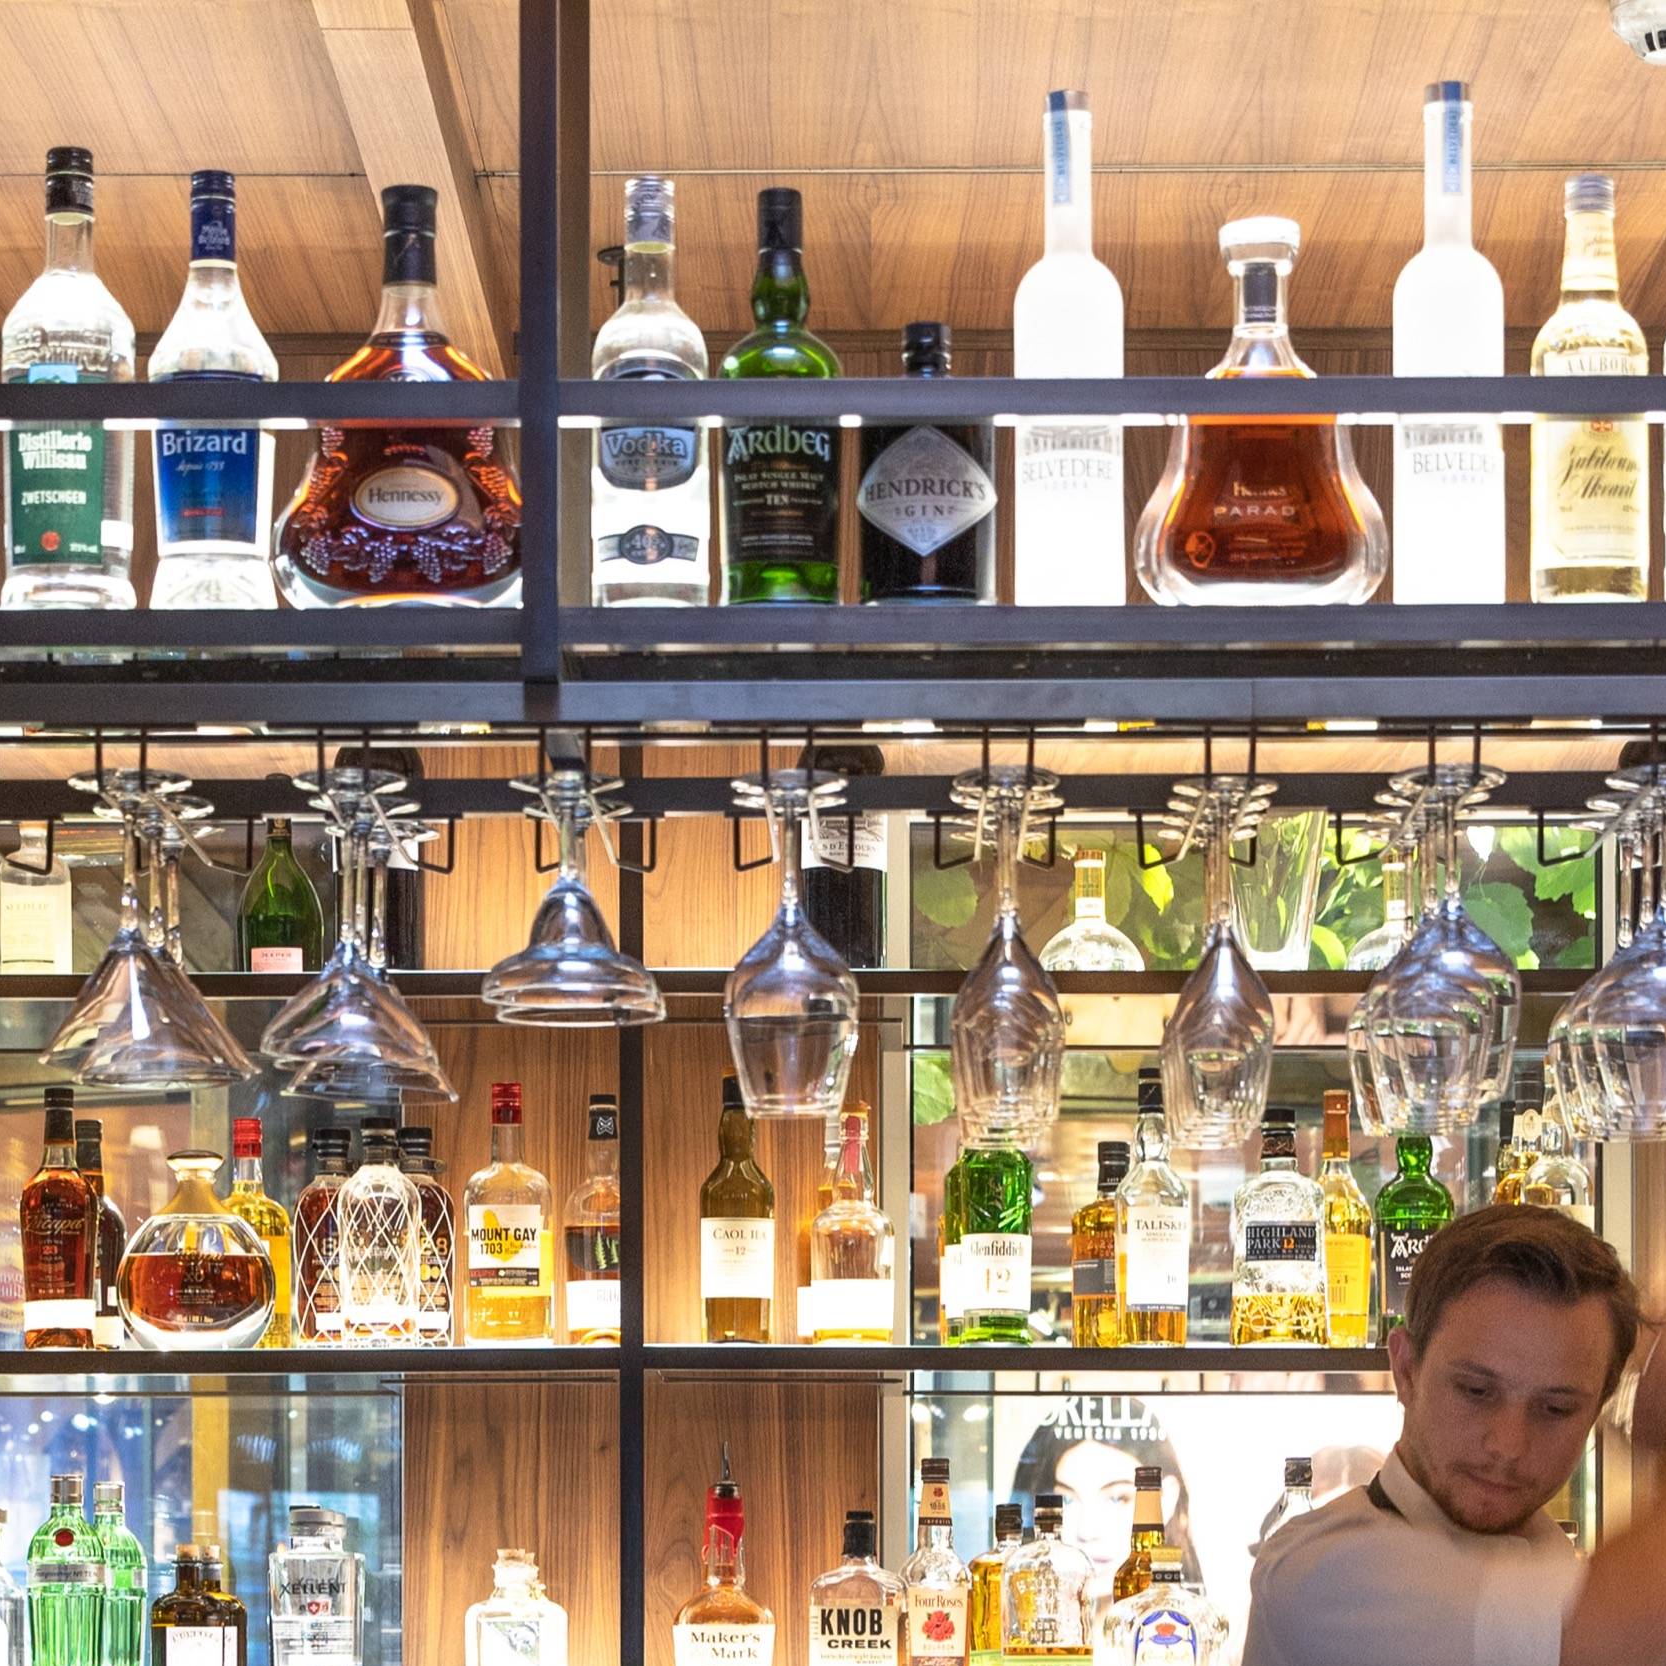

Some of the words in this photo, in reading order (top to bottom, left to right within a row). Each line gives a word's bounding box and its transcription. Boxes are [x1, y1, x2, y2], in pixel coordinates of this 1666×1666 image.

[161, 430, 248, 457] Brizard
[605, 430, 688, 459] Vodka
[1412, 449, 1499, 476] BELVEDE
[1021, 458, 1114, 483] BELVEDERE
[368, 485, 443, 505] Hennessy
[864, 478, 987, 502] HENDRICK'S
[765, 494, 790, 507] TEN
[904, 504, 945, 517] GIN
[1134, 1219, 1188, 1232] TALISKE
[1245, 1225, 1318, 1240] HIGHLAND
[471, 1227, 510, 1242] MOUNT
[512, 1227, 537, 1243] GAY
[712, 1228, 747, 1241] CAOL
[480, 1241, 503, 1256] 1703
[1246, 1237, 1280, 1251] PARK
[1282, 1238, 1295, 1250] 12
[279, 1582, 347, 1598] XELLENT
[935, 1595, 964, 1609] Roses
[820, 1608, 883, 1637] KNOB
[690, 1630, 762, 1644] Maker's
[827, 1638, 892, 1651] CREEK
[710, 1645, 759, 1660] Mark
